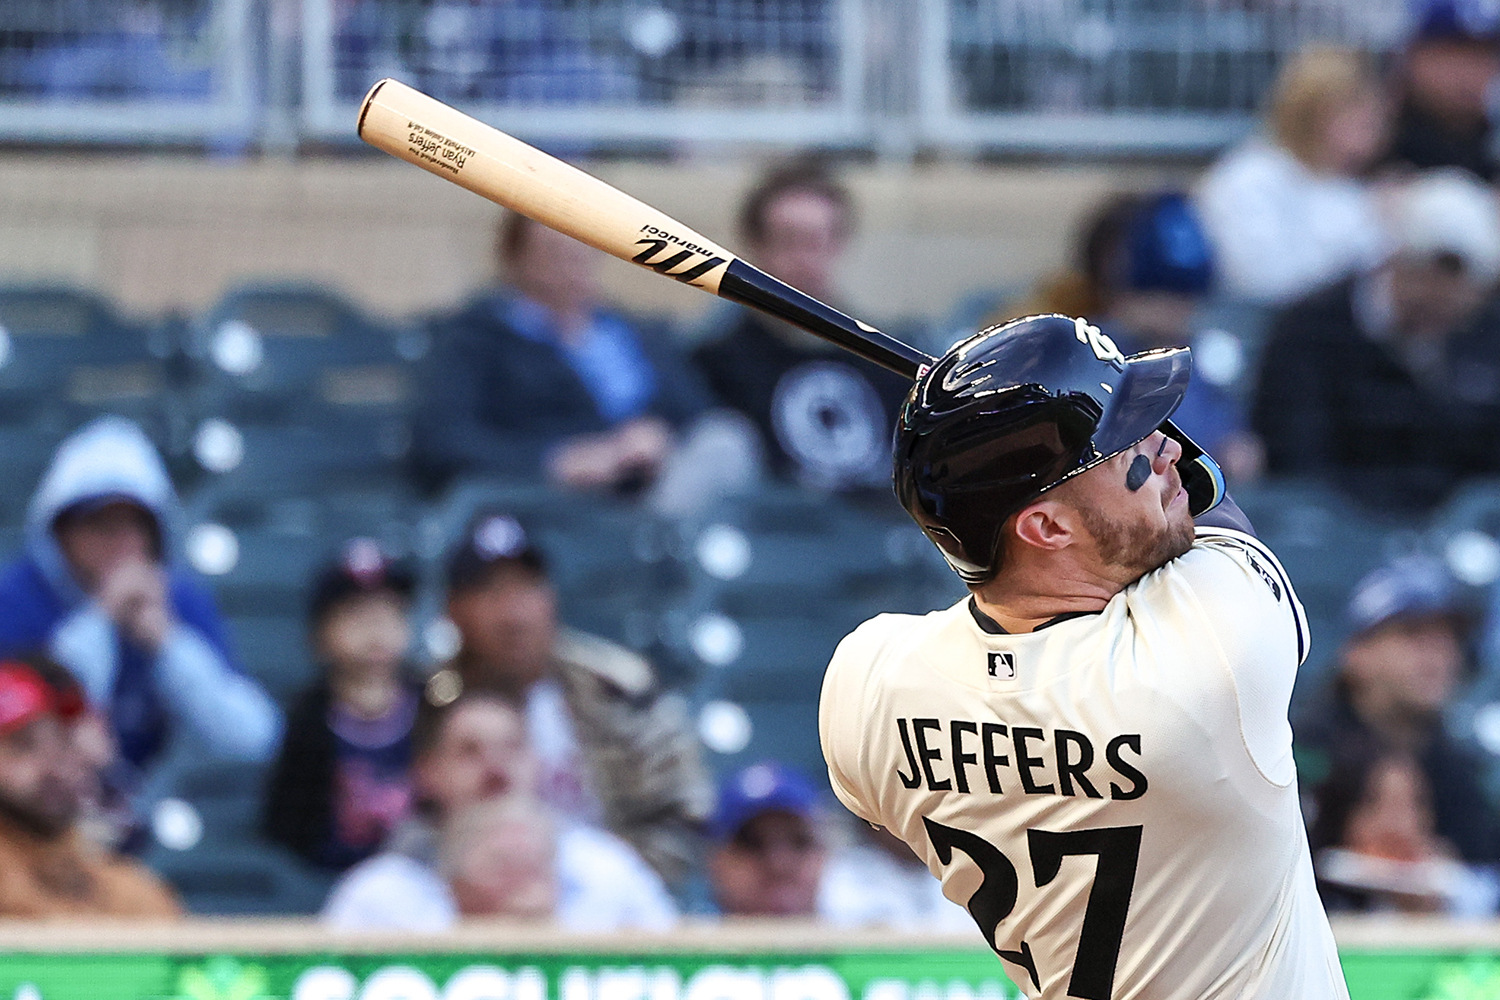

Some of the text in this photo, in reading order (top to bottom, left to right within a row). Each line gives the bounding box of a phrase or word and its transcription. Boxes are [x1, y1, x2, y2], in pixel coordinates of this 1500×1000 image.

[408, 132, 467, 169] Ryan Jeffers
[640, 224, 714, 257] marucci
[896, 718, 1149, 801] JEFFERS
